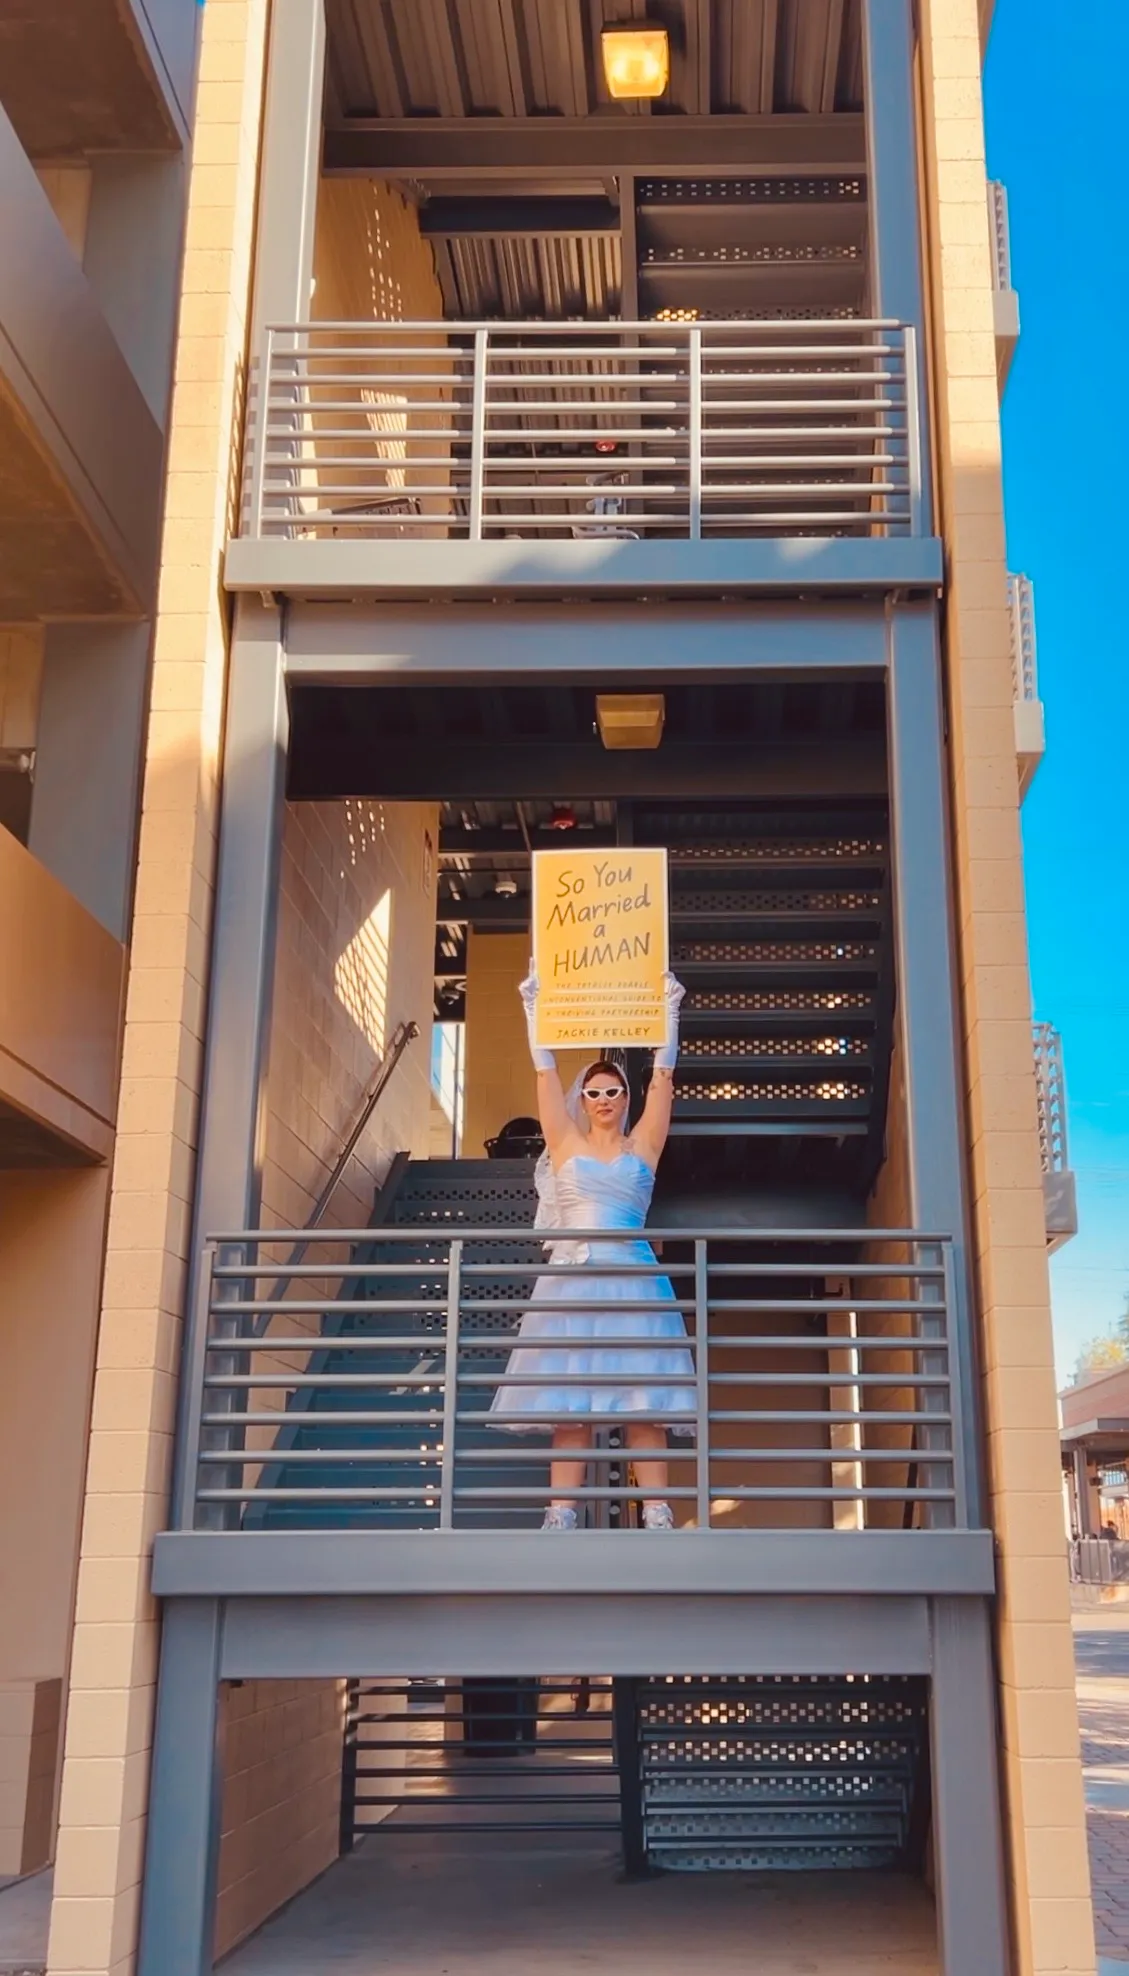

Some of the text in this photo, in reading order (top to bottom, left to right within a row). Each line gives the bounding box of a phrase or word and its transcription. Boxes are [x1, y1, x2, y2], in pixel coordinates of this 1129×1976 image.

[556, 861, 632, 898] So You
[546, 883, 651, 930] Married
[593, 923, 605, 938] a
[553, 931, 650, 977] HUMAN
[556, 1027, 651, 1039] JACKIE KELLEY
